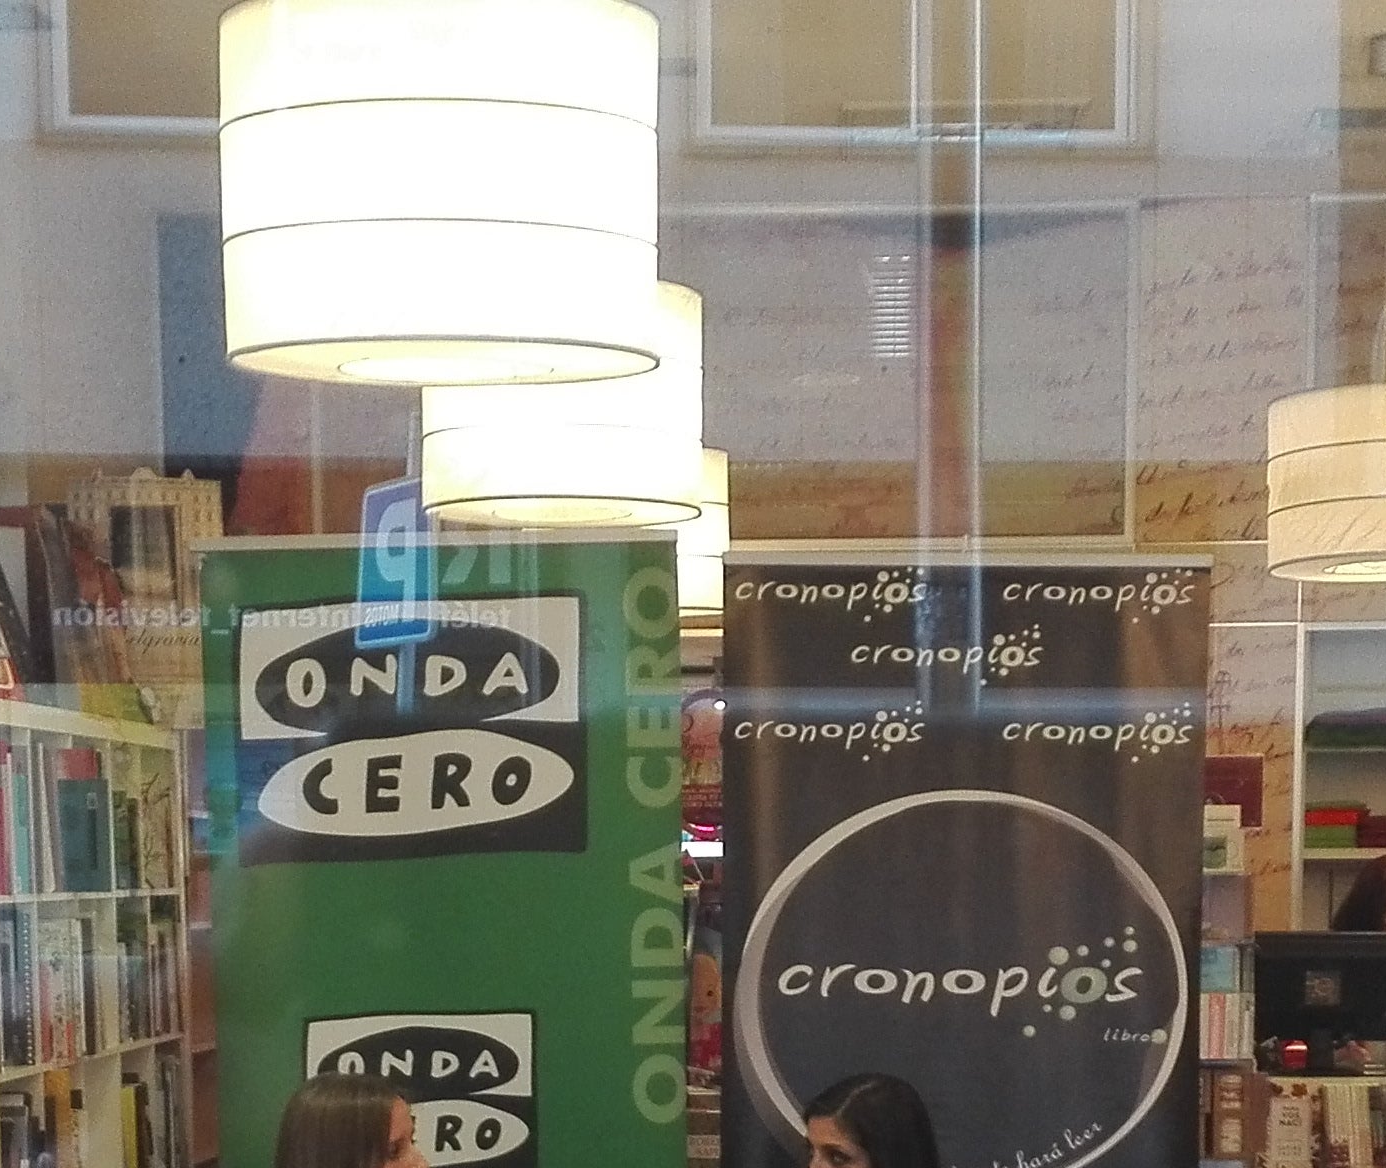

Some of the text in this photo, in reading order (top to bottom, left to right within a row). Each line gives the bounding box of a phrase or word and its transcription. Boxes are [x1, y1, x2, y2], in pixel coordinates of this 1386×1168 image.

[734, 570, 928, 611] cronopios
[1002, 572, 1195, 612] cronopios
[850, 634, 1044, 675] cronopios
[285, 652, 530, 709] ONDA
[624, 566, 683, 809] CERO
[733, 710, 926, 750] cronopios
[1001, 712, 1194, 751] cronopios
[302, 751, 534, 815] CERO
[629, 841, 687, 1125] ONDA
[777, 945, 1145, 1018] cronopios
[335, 1047, 501, 1079] ONDA
